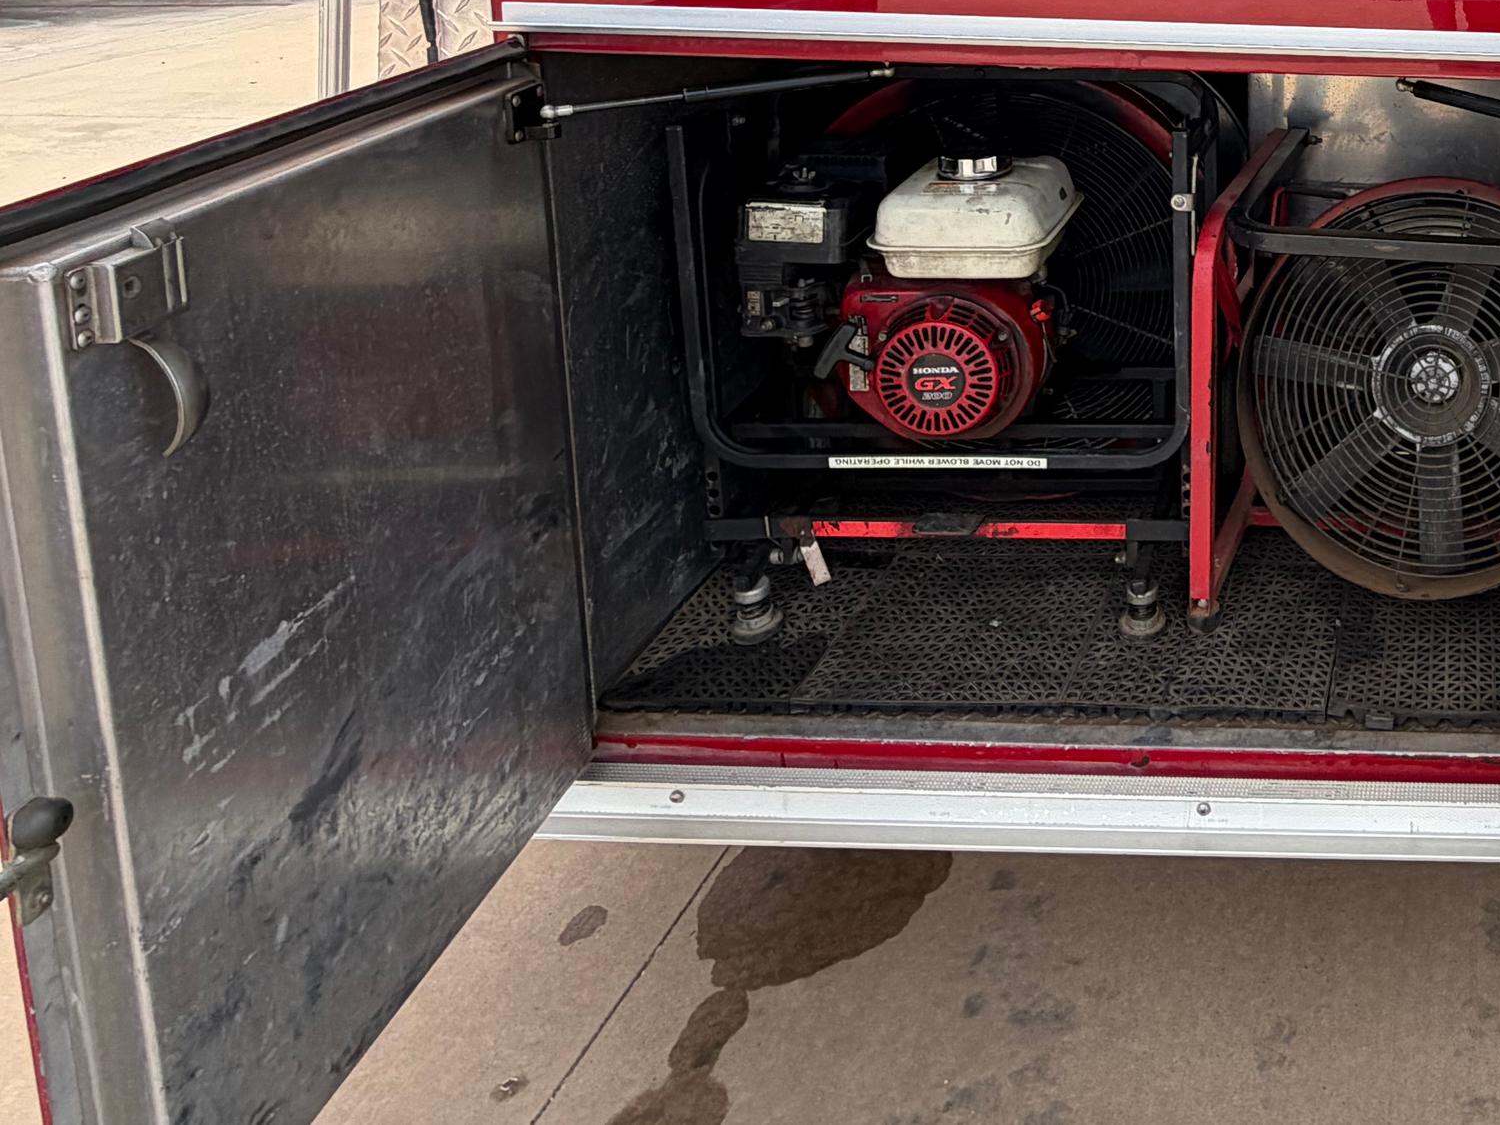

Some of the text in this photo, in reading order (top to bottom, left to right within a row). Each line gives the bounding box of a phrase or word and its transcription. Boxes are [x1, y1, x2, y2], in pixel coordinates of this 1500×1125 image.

[912, 366, 959, 374] HONDA
[914, 376, 957, 391] GX
[927, 458, 970, 466] BLOWER
[973, 458, 1001, 466] MOVE
